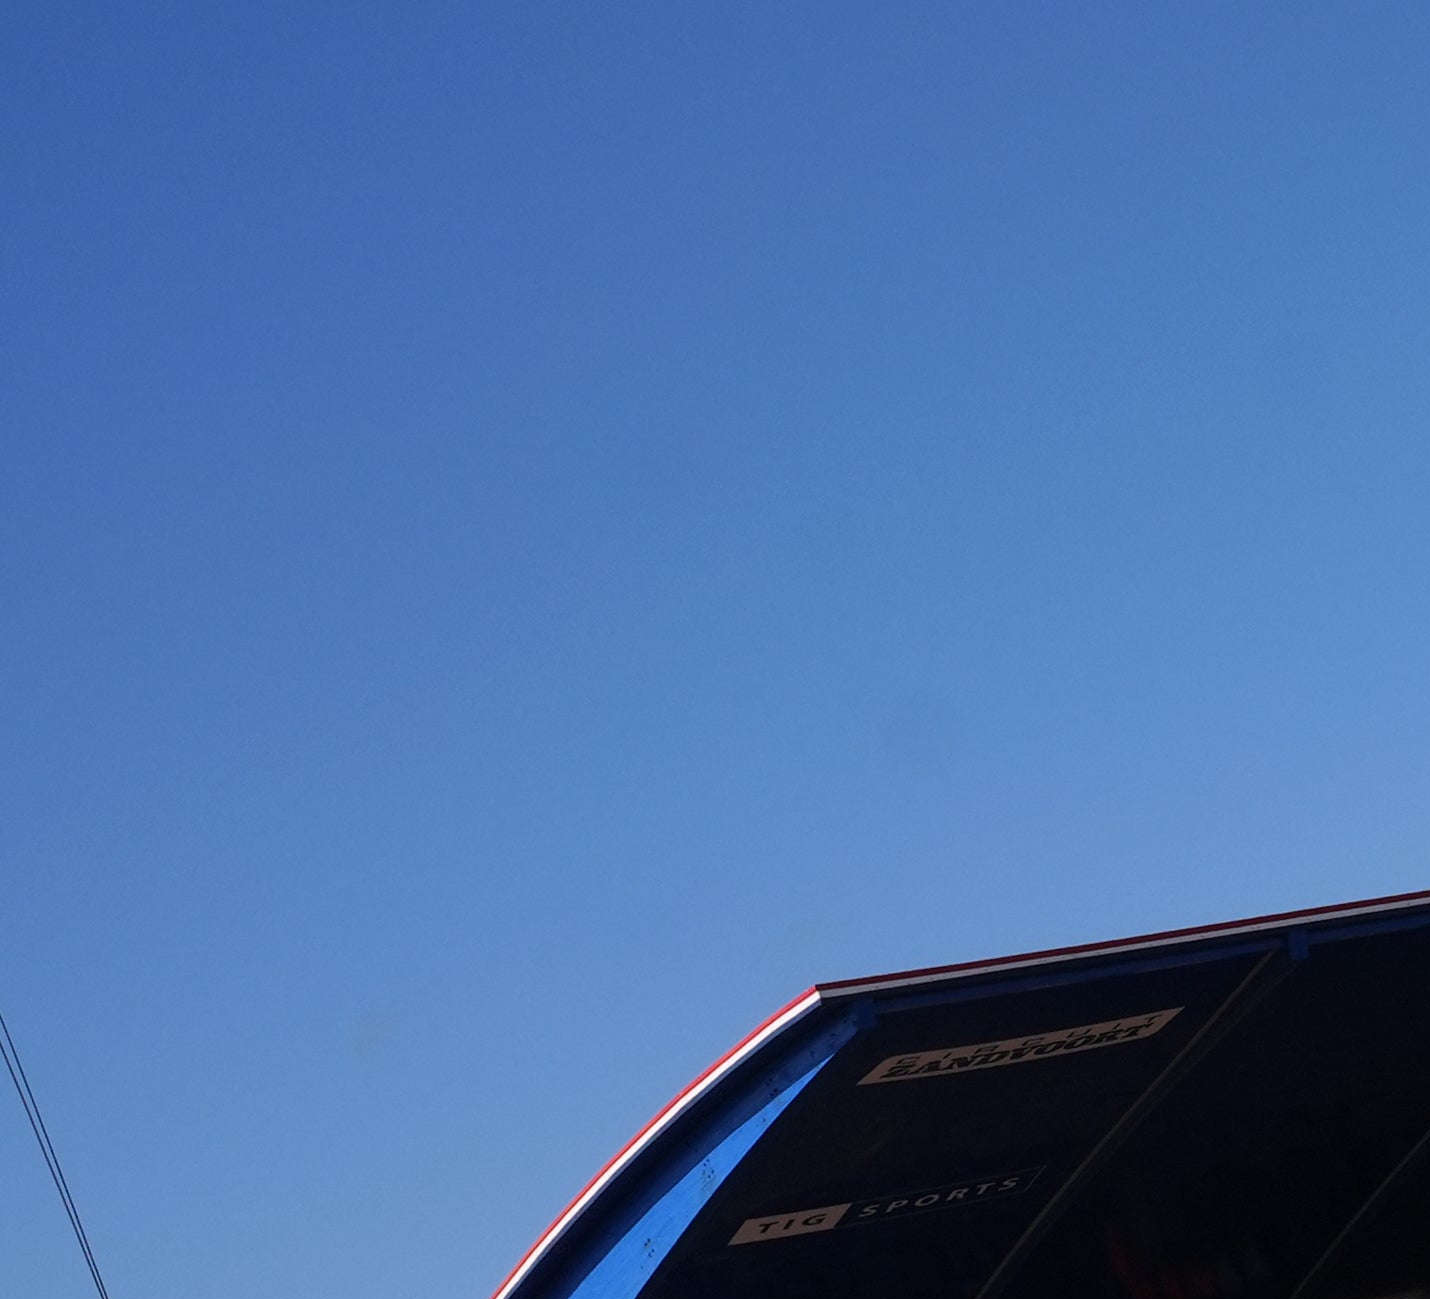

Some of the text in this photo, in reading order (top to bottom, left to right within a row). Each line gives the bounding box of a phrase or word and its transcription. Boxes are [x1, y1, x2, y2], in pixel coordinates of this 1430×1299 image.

[879, 1022, 1155, 1080] ZANDVOORT
[897, 1014, 1163, 1066] CIRCUIT
[758, 1176, 1021, 1234] TIG SPORTS
